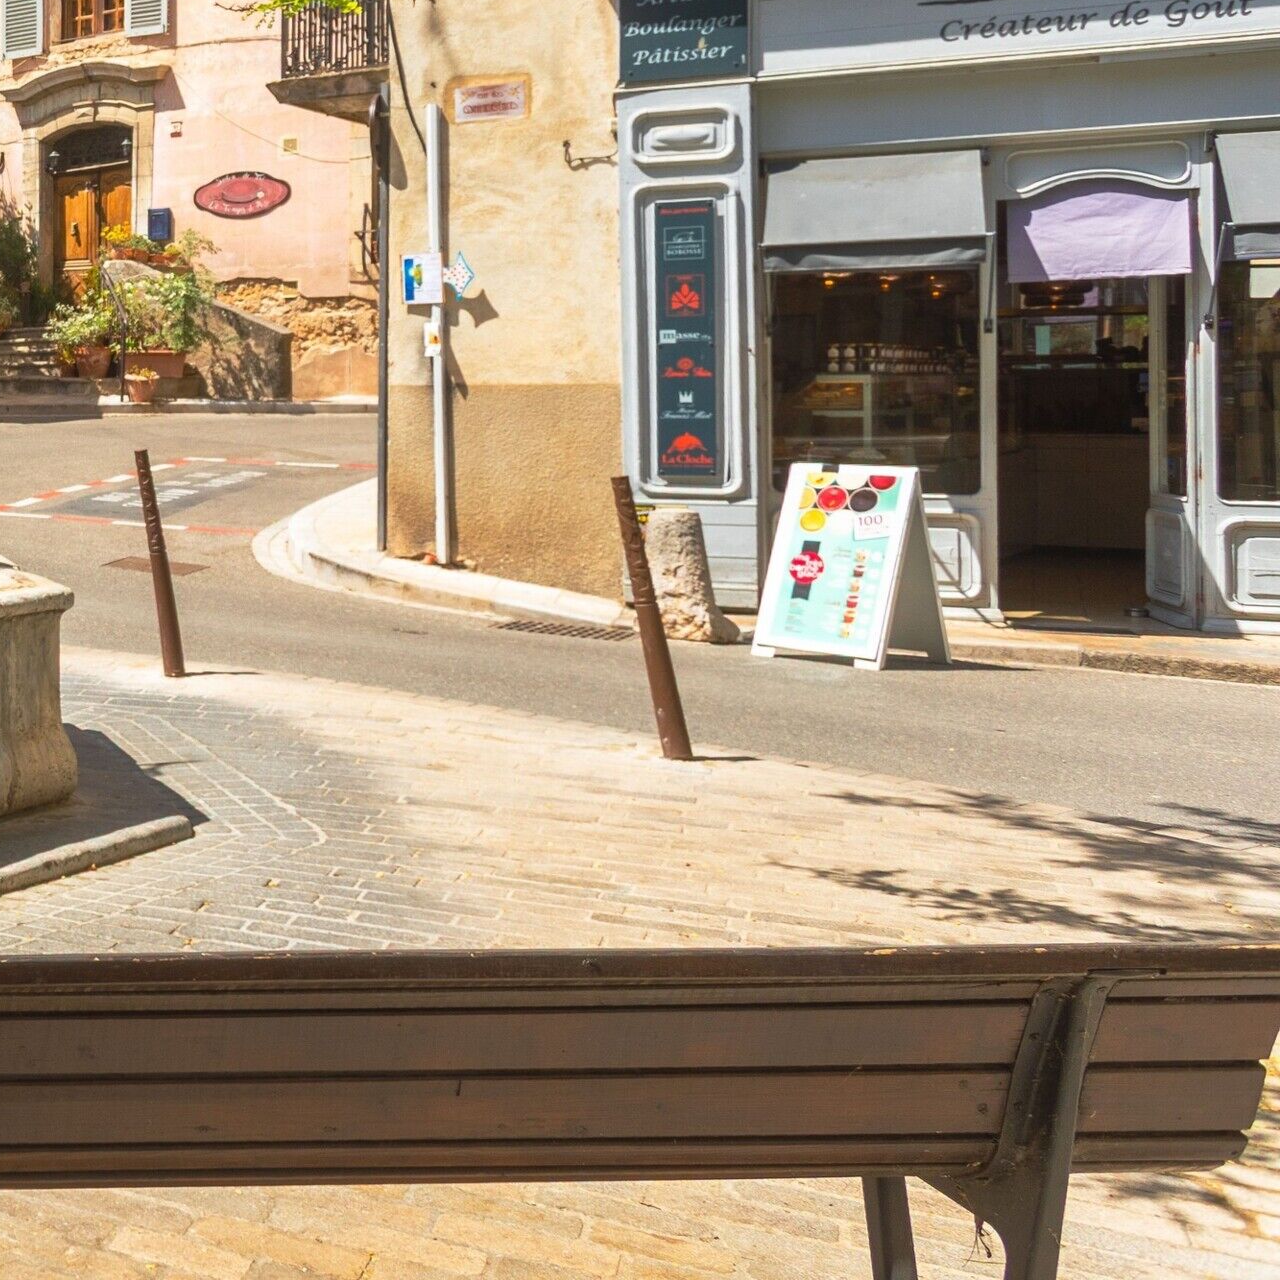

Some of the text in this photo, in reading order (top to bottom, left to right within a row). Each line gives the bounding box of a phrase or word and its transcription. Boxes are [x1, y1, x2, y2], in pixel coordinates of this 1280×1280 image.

[623, 14, 743, 37] Boulanger
[940, 11, 1099, 42] Créateur
[1109, 0, 1151, 27] de
[633, 45, 734, 66] Pâtissier
[859, 515, 883, 526] 100
